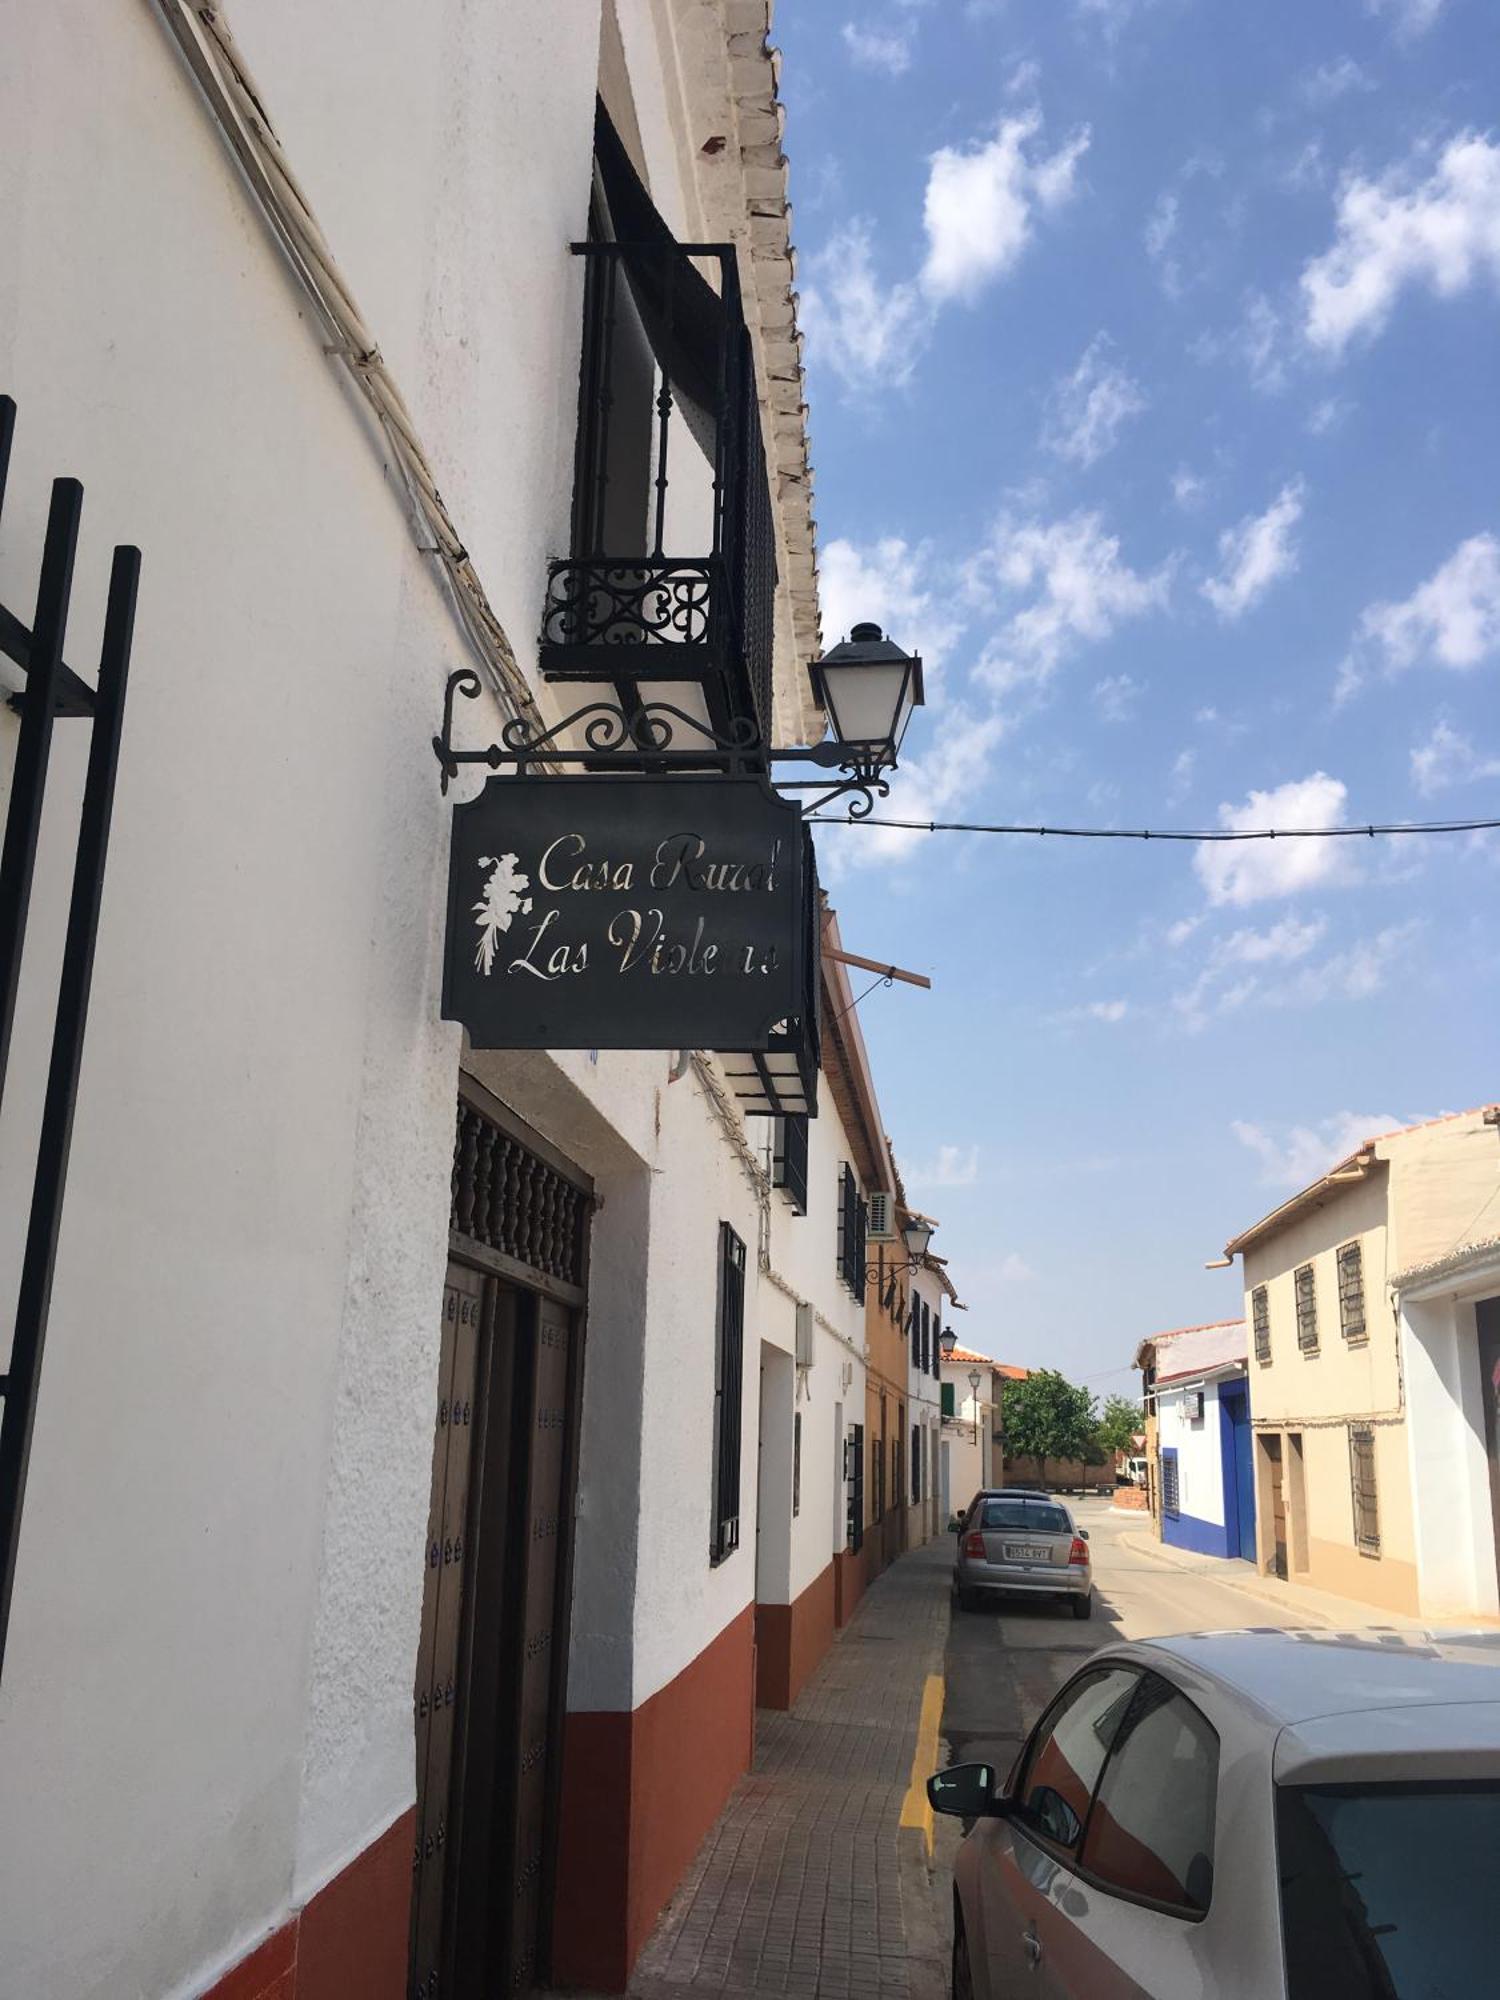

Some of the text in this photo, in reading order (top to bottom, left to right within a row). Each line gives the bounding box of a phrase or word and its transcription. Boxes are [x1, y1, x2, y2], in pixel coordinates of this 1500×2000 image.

[540, 832, 781, 892] Casa Rural
[508, 908, 779, 980] Las Violes
